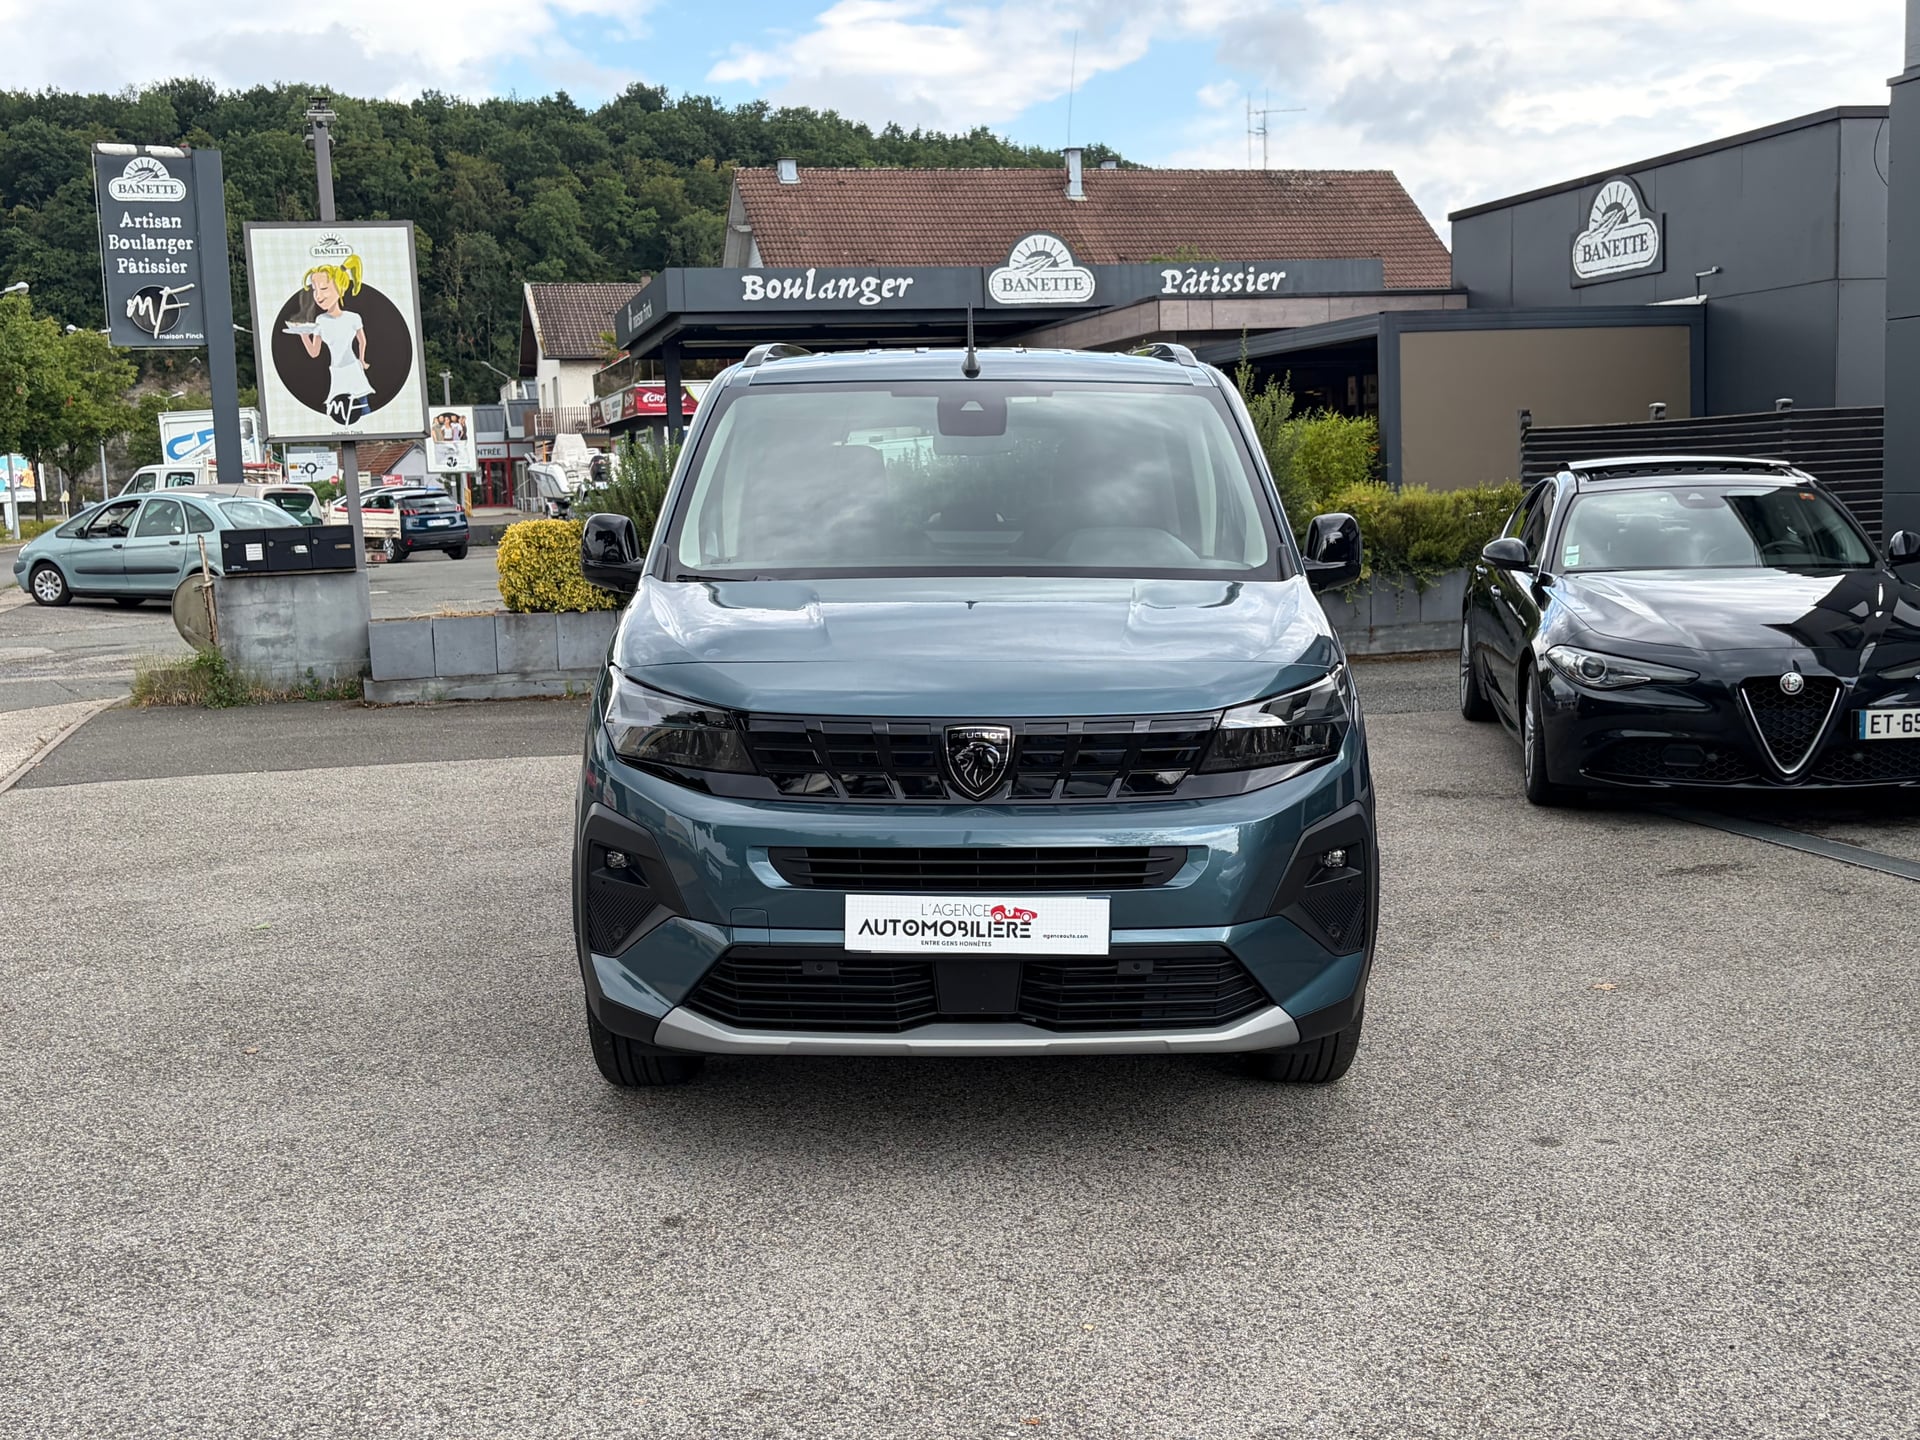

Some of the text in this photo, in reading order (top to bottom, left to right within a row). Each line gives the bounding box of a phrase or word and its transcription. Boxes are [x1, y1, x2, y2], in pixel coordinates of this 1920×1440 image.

[118, 184, 179, 195] BANETTE
[119, 211, 182, 228] Artisan
[108, 234, 194, 255] Boulanger
[314, 247, 350, 255] BANETTE
[1582, 232, 1649, 264] BANETTE
[117, 257, 188, 274] Pâtissier
[741, 267, 914, 306] Boulanger
[1000, 275, 1085, 294] BANETTE
[1160, 266, 1287, 294] Pâtissier
[477, 447, 502, 456] NTRÉE
[951, 732, 1005, 740] PEUGEOT
[921, 903, 991, 918] L'AGENCE
